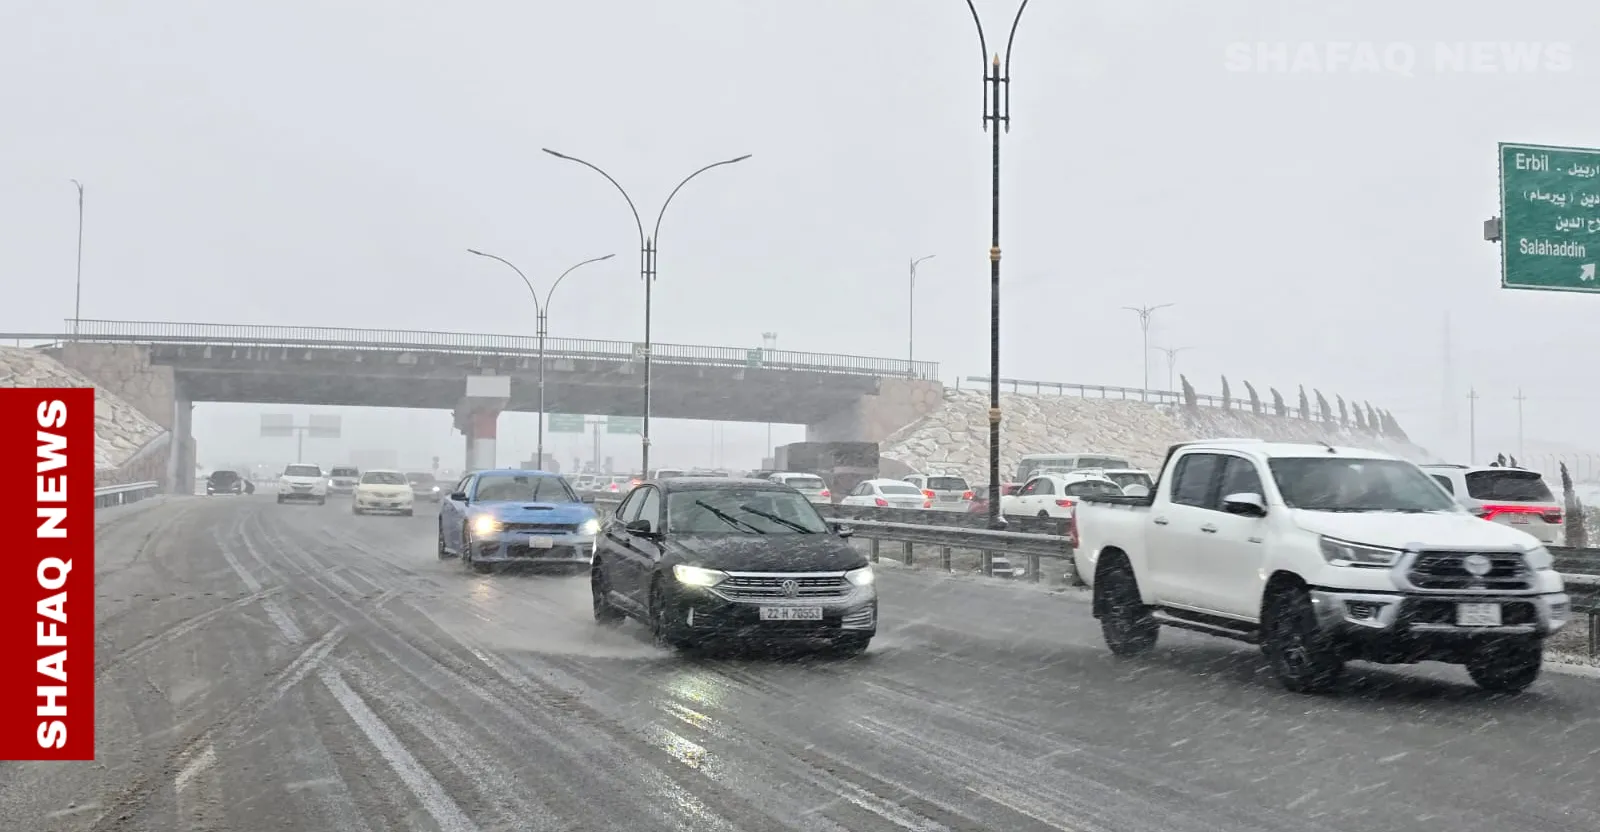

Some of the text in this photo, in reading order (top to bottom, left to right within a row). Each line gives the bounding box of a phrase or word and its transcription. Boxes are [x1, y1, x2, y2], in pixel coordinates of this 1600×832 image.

[1516, 152, 1549, 171] Erbil
[1519, 238, 1586, 258] Salahaddin
[767, 608, 780, 619] 22
